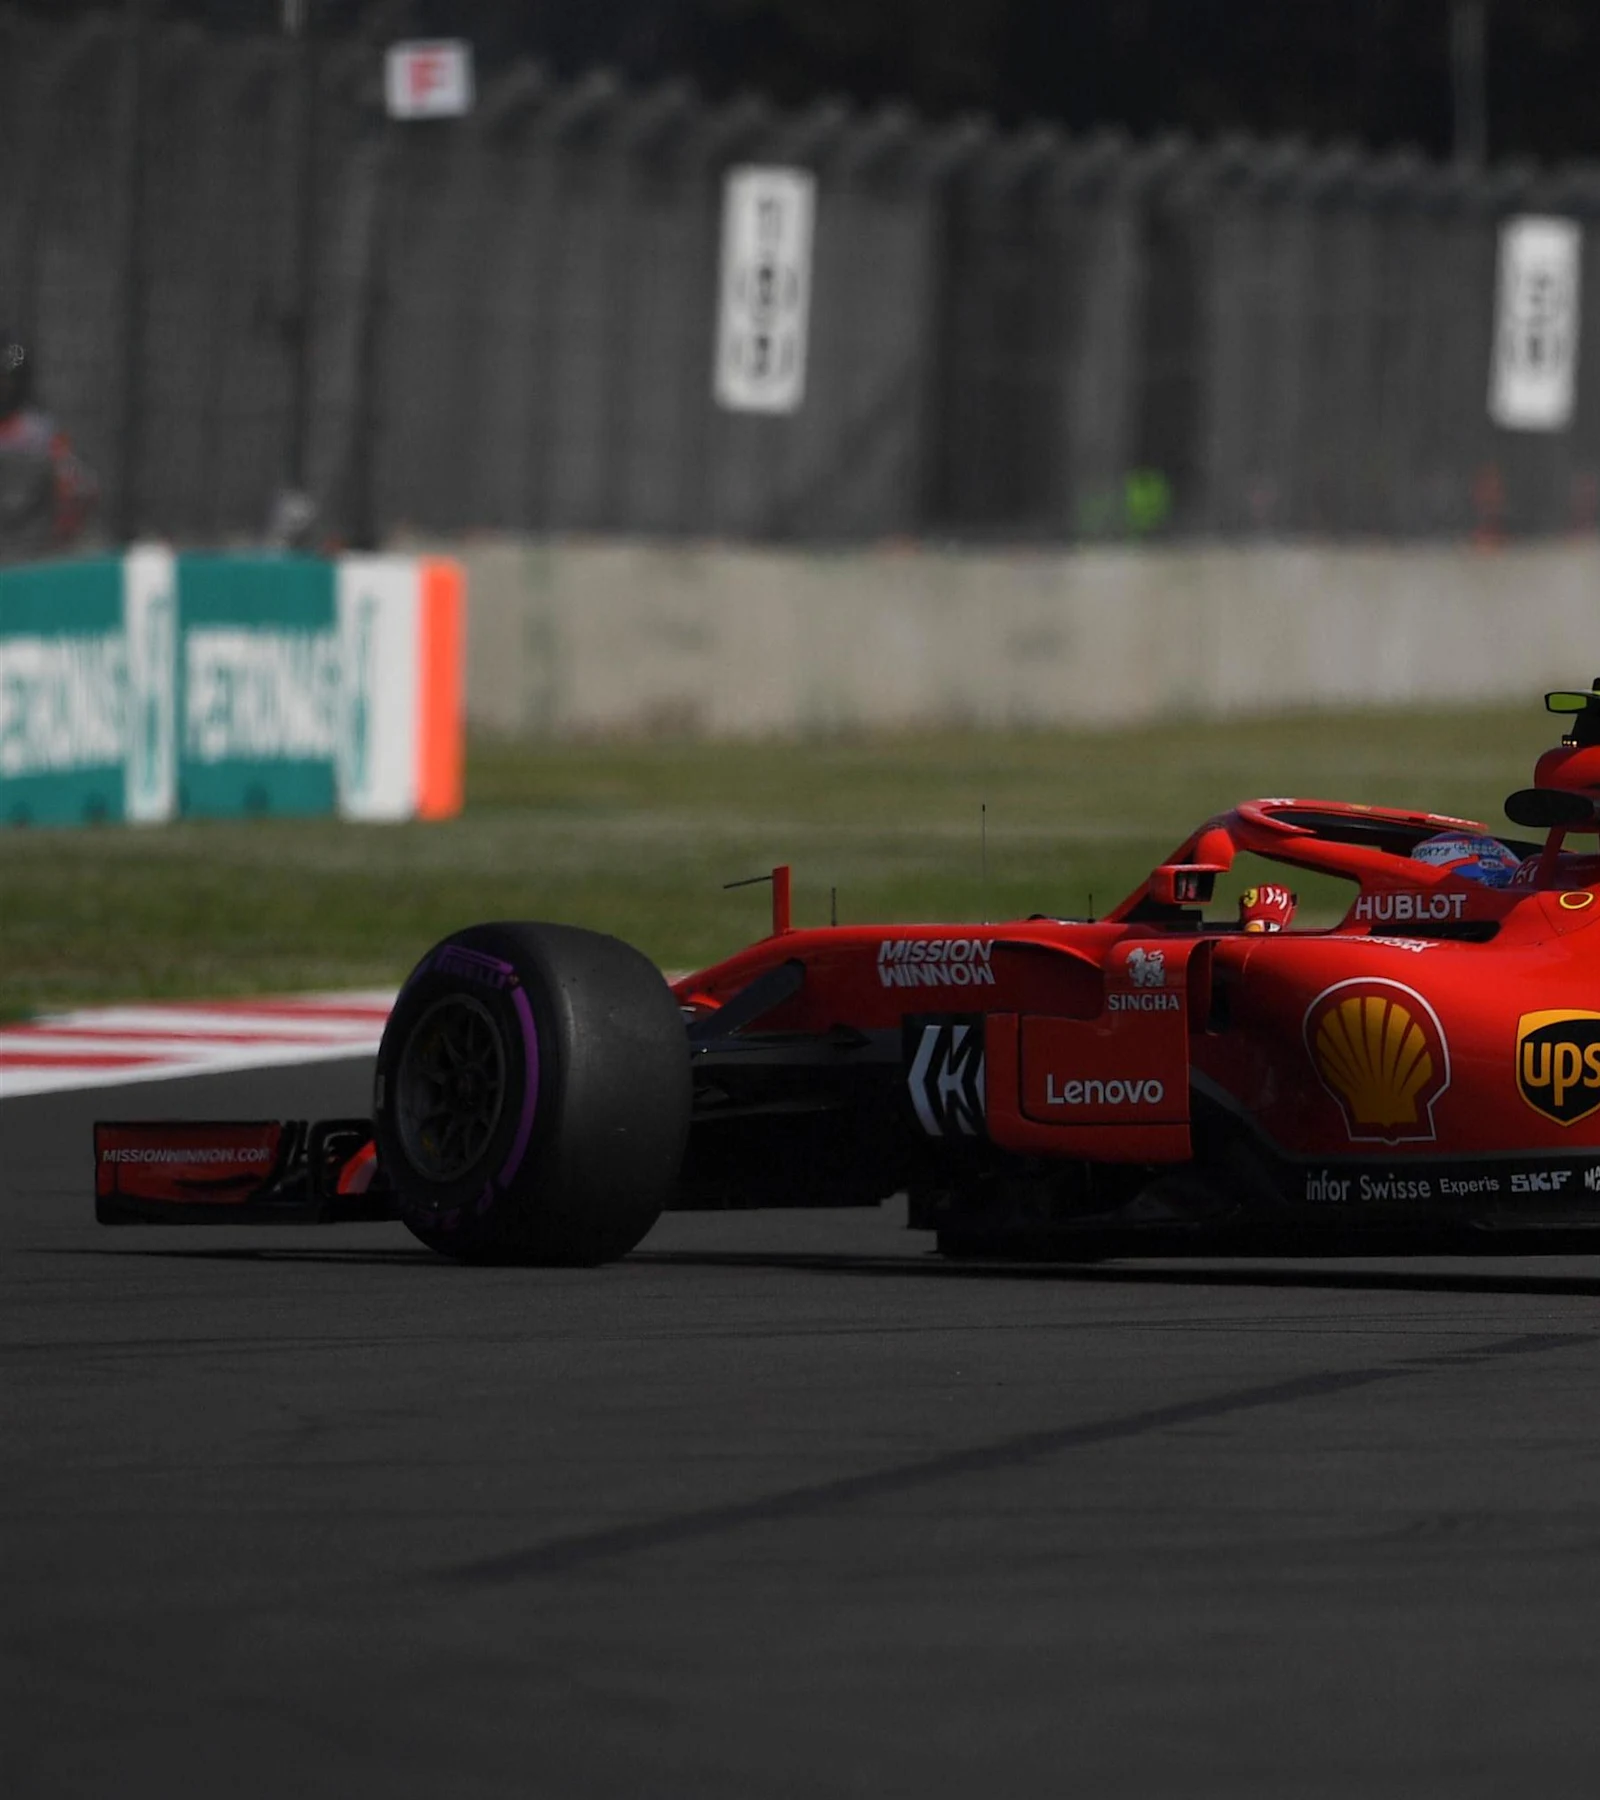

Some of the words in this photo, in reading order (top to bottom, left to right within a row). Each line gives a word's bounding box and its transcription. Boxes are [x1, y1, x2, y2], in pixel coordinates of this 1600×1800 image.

[1354, 893, 1467, 921] HUBLOT
[877, 938, 995, 964] MISSION
[877, 962, 997, 987] WINNOW
[1107, 993, 1181, 1012] SINGHA
[1046, 1073, 1165, 1106] Lenovo
[1306, 1169, 1351, 1201] infor
[1359, 1172, 1433, 1201] Swisse
[1439, 1177, 1500, 1198] Experis
[1510, 1169, 1573, 1193] SKF
